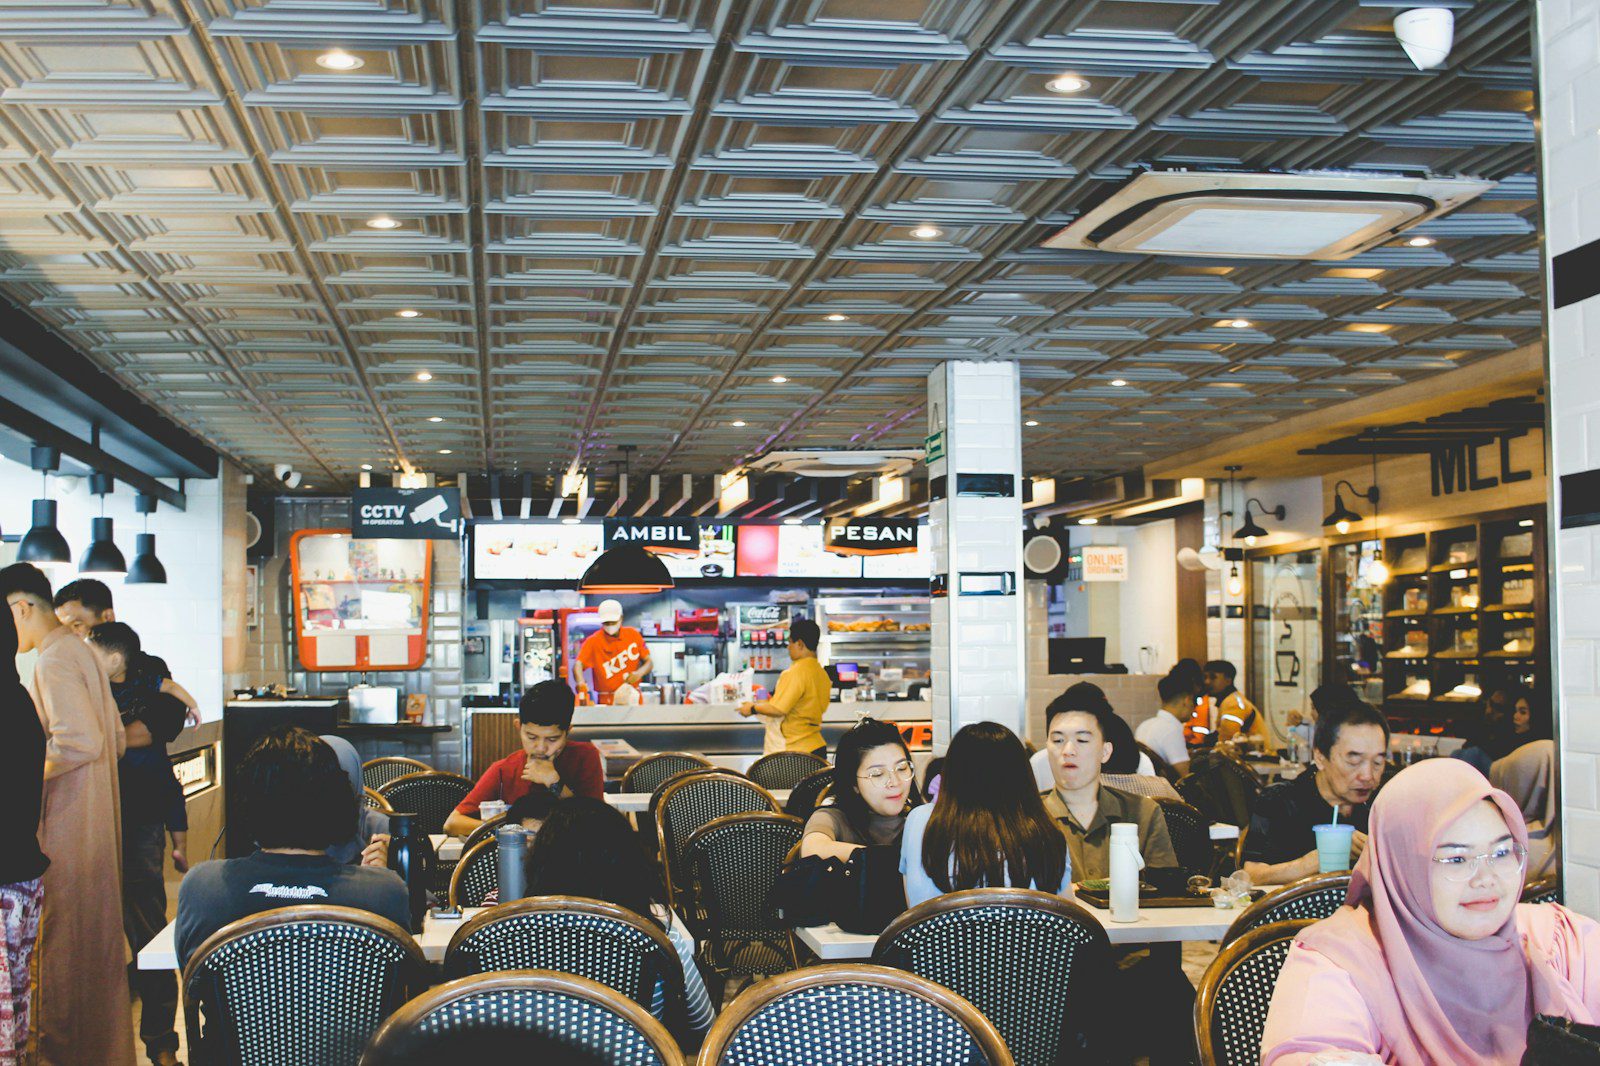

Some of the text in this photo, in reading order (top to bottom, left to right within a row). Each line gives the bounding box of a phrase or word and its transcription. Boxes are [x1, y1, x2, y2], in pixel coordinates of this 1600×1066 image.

[360, 504, 405, 519] CCTV
[612, 525, 692, 541] AMBIL
[830, 525, 913, 541] PESAN
[1087, 553, 1124, 566] ONLINE
[602, 642, 640, 680] KFC
